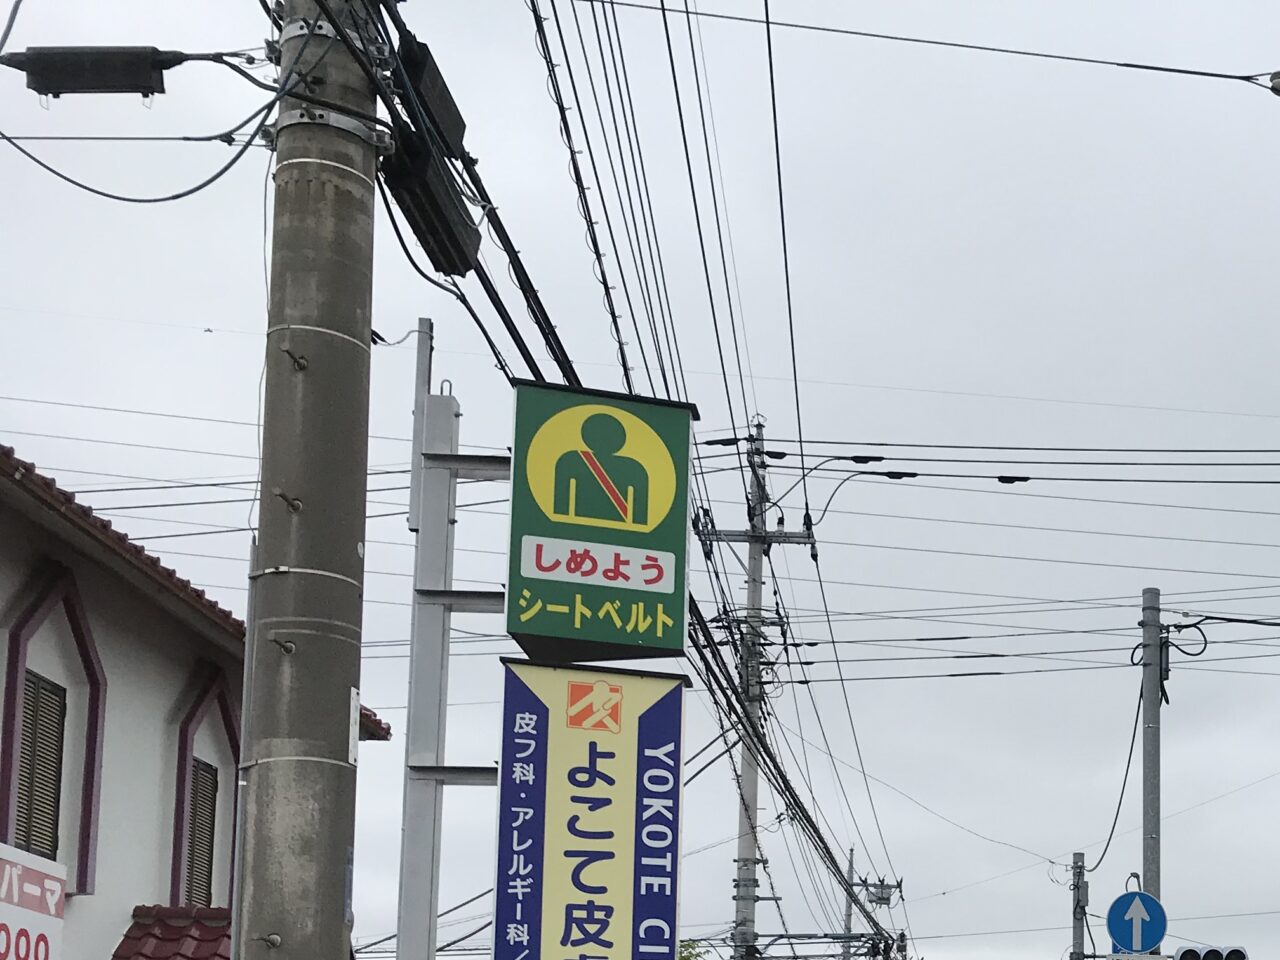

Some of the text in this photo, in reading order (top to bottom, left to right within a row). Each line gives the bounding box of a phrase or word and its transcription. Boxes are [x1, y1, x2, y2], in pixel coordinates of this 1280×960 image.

[535, 544, 664, 585] しめよう
[518, 588, 674, 638] シートベルト
[640, 741, 676, 896] YOKOTE
[0, 864, 62, 915] パーマ
